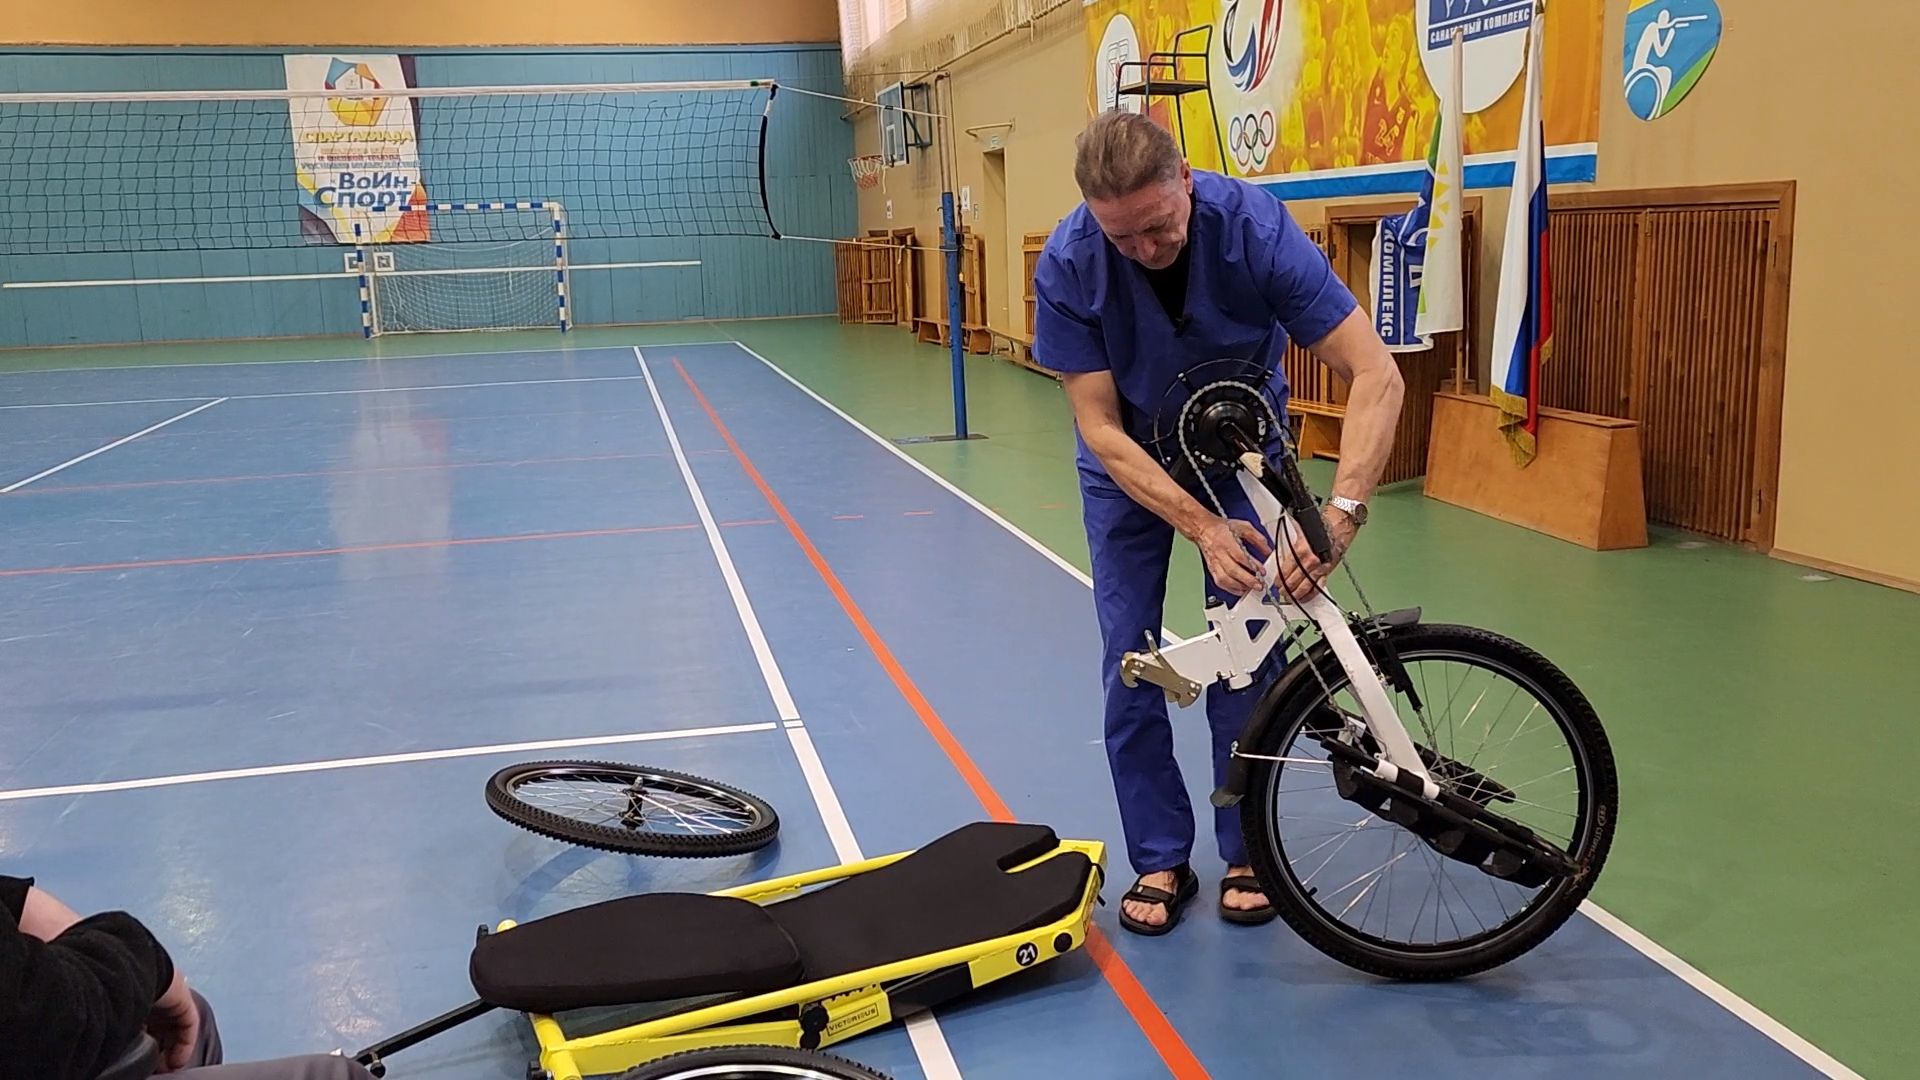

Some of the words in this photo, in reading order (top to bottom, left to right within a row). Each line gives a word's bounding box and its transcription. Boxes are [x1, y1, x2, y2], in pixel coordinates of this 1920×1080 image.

[1483, 8, 1531, 31] КОМПЛЕКС
[1381, 228, 1395, 337] КОМПЛЕКС
[1019, 944, 1036, 964] 21
[829, 1008, 876, 1031] VICTORIOUS
